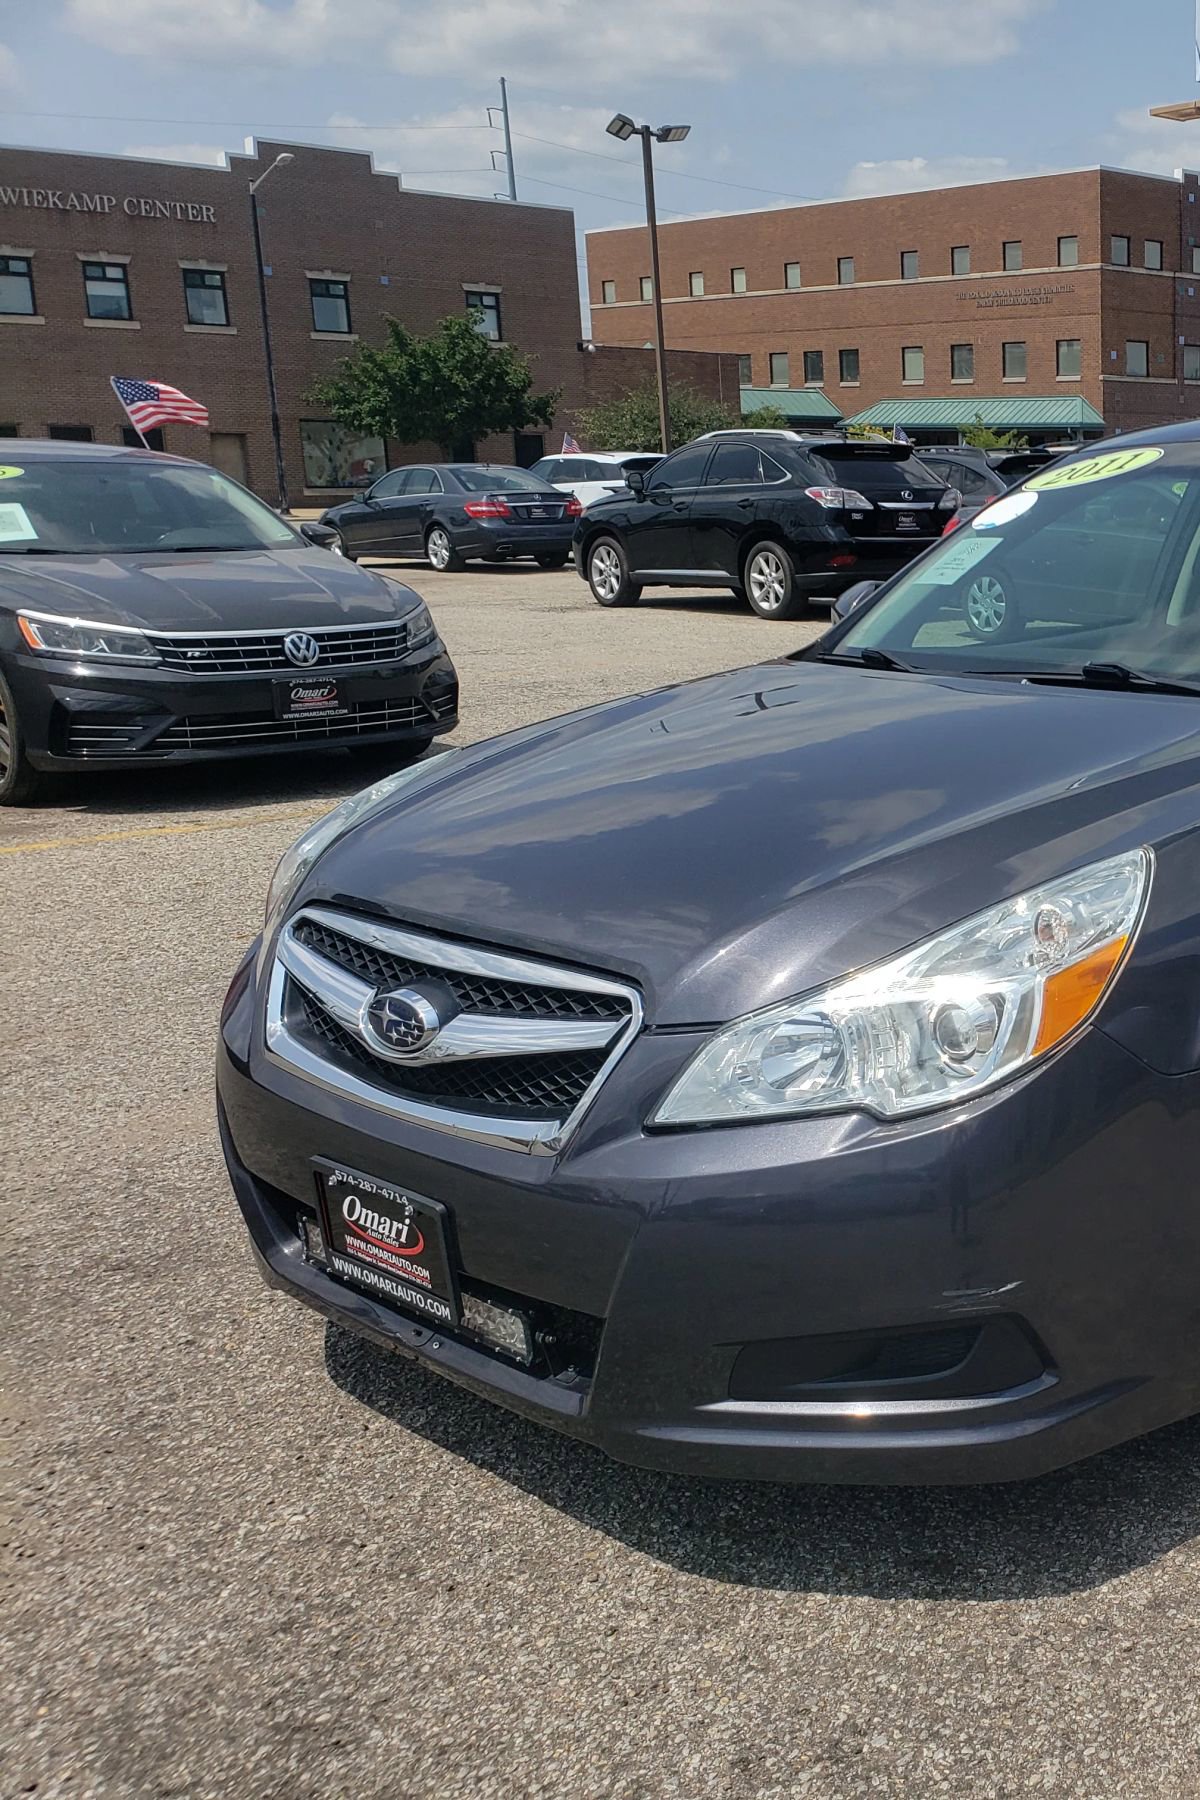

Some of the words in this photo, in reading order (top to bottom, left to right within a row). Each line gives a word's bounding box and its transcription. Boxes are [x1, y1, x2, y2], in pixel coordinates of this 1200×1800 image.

[0, 186, 116, 213] WIEKAMP
[123, 196, 217, 223] CENTER
[1040, 452, 1146, 487] 2011
[291, 685, 331, 699] Omari
[335, 1170, 409, 1205] 574-287-4714
[342, 1195, 411, 1244] Omari
[367, 1228, 382, 1240] Auto
[383, 1234, 400, 1247] Sales
[345, 1234, 431, 1280] WWW.OMARIAUTO.COM
[332, 1256, 451, 1320] WWW.OMARIAUTO.COM
